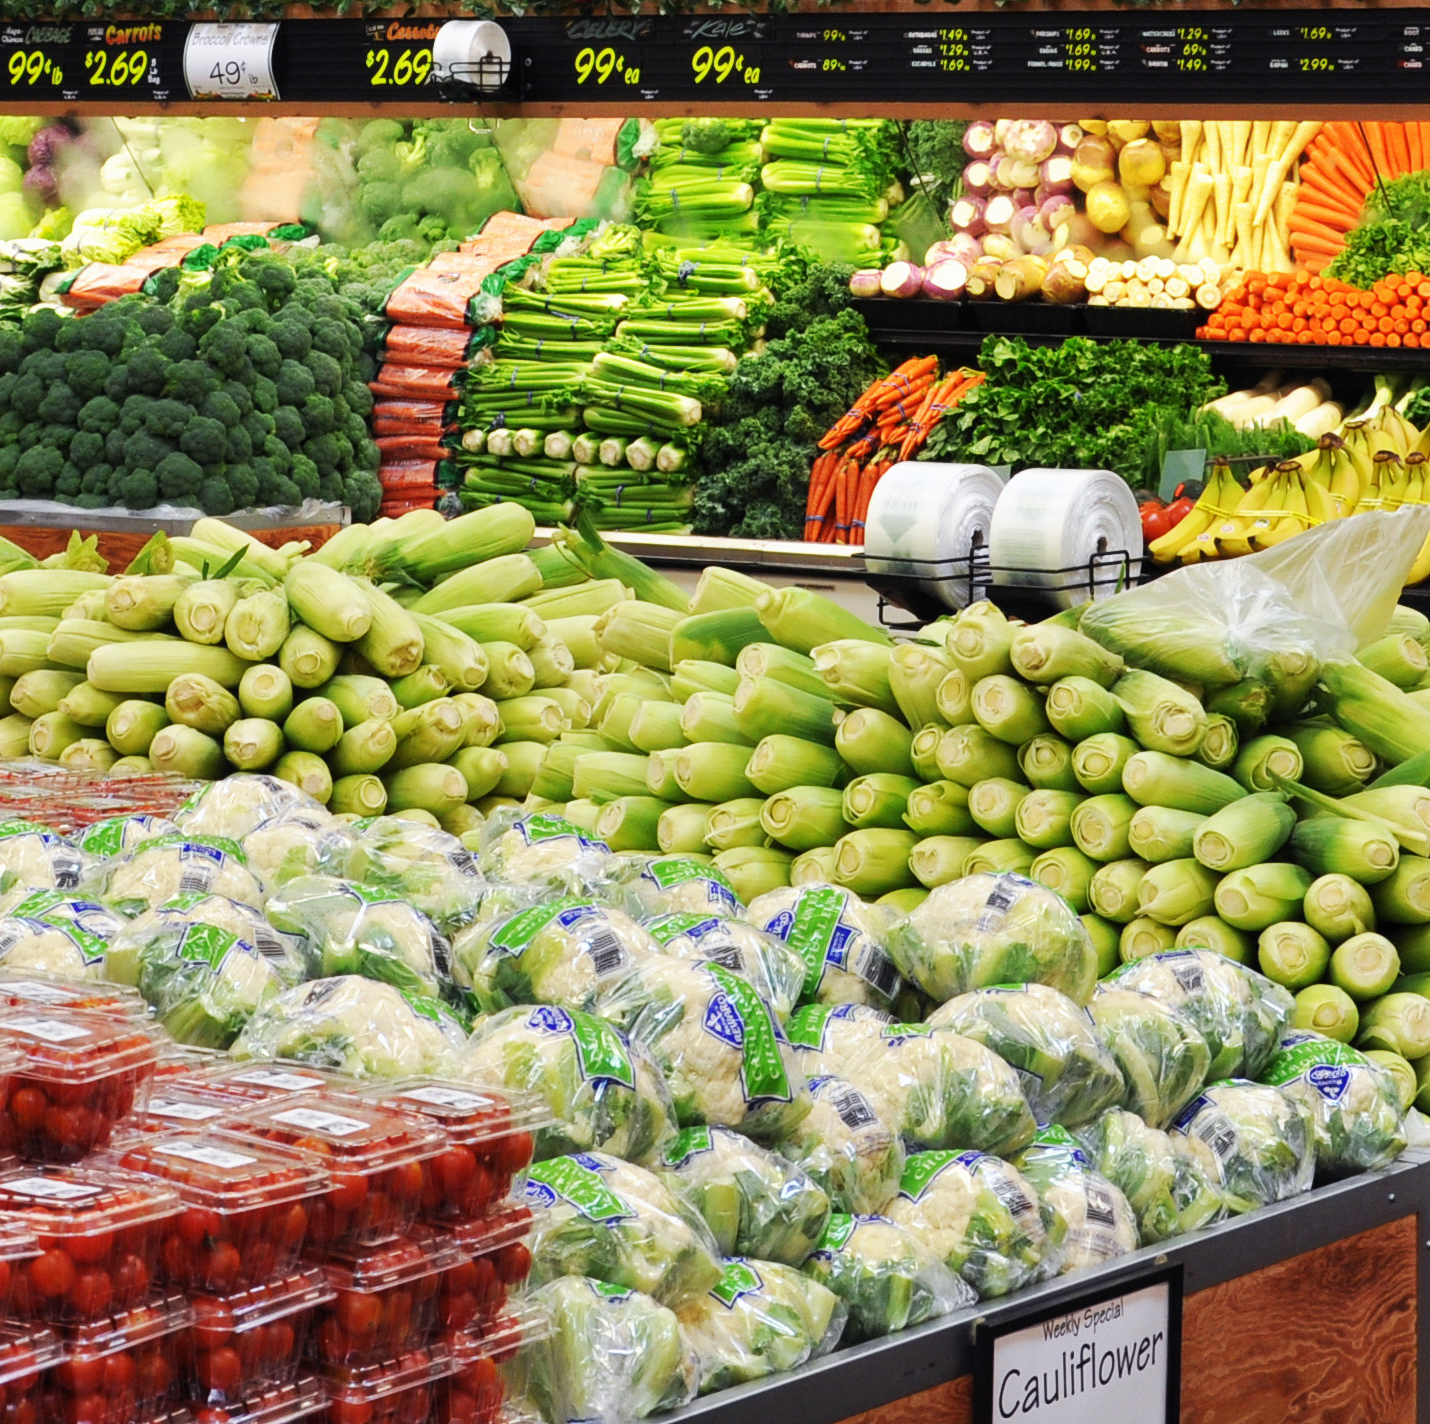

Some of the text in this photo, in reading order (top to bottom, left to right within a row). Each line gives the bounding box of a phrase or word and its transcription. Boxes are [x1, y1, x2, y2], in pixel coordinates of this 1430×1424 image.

[25, 26, 72, 45] CABBAGE
[105, 23, 162, 45] Carrots
[192, 32, 268, 46] Broccoli Crowns
[568, 19, 645, 41] CELERY
[691, 19, 751, 39] Kale
[9, 51, 63, 85] 99¢ lb
[85, 50, 147, 85] $2.69
[209, 61, 247, 85] 49¢
[366, 49, 433, 85] $2.69
[575, 48, 640, 84] 99¢ ea
[692, 46, 760, 84] 99¢ ea
[1042, 1297, 1124, 1342] Weekly Special
[999, 1331, 1163, 1419] Cauliflower
